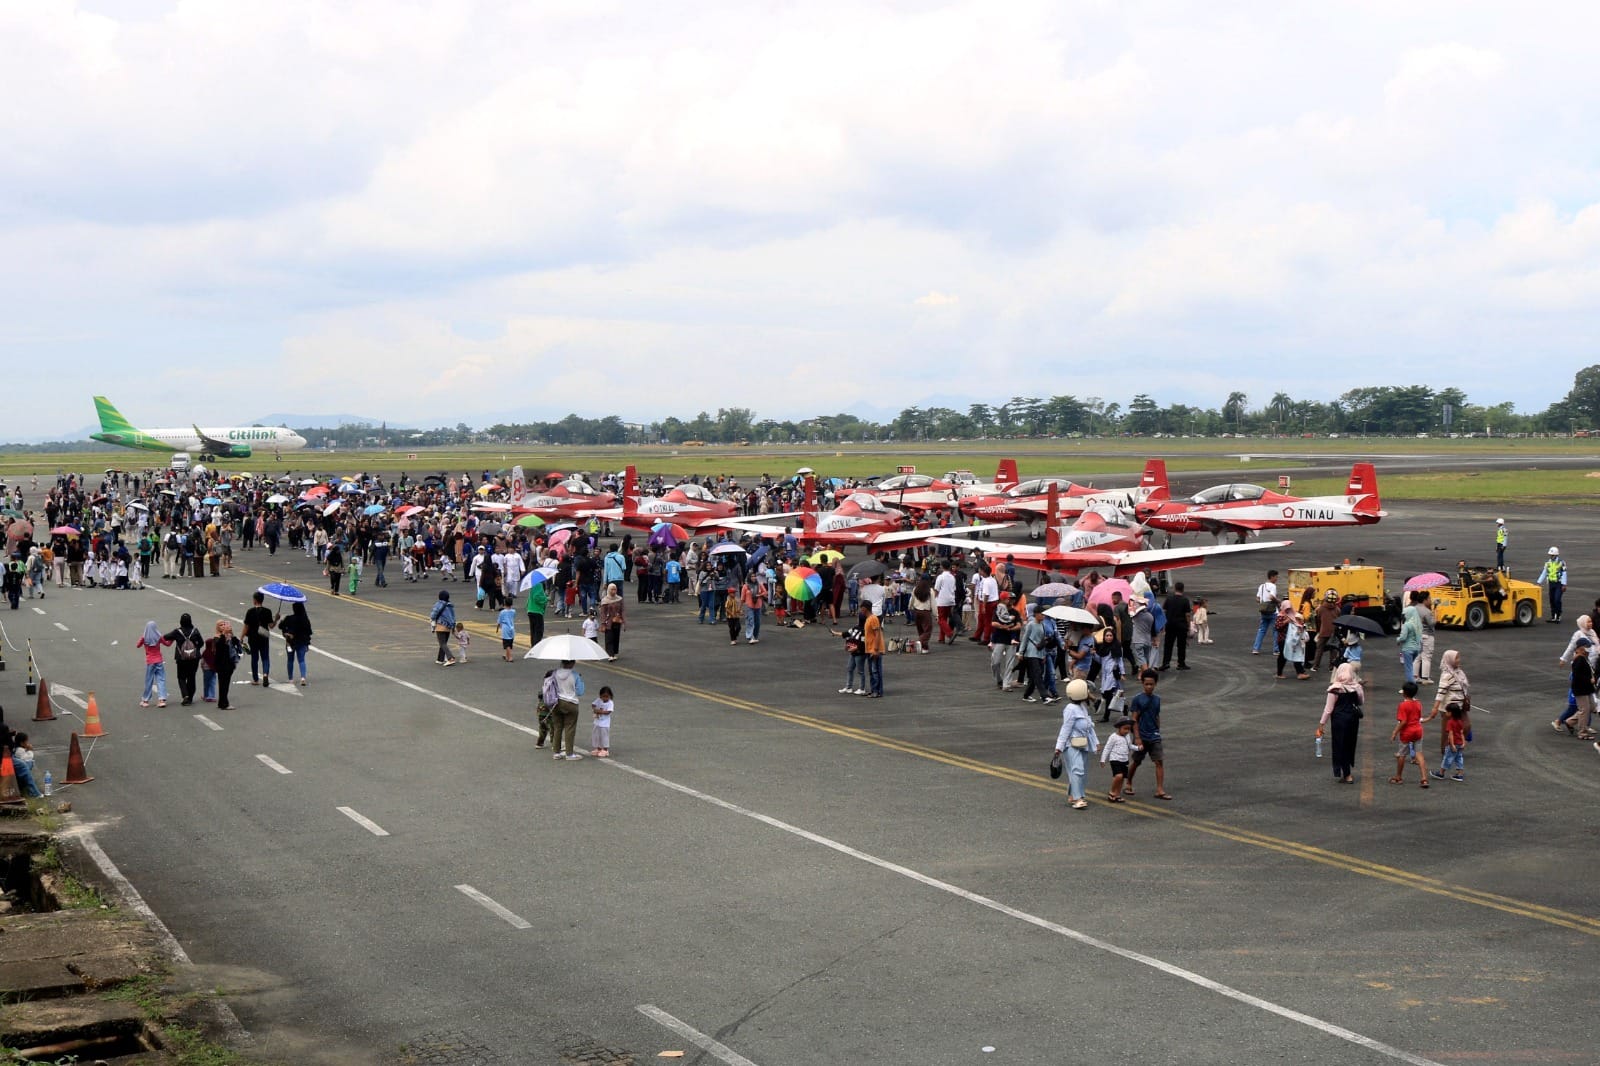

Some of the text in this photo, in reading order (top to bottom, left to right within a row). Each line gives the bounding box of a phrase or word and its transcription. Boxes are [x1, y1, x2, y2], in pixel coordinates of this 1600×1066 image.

[229, 430, 277, 440] Citilink
[1298, 508, 1334, 520] TNI AU
